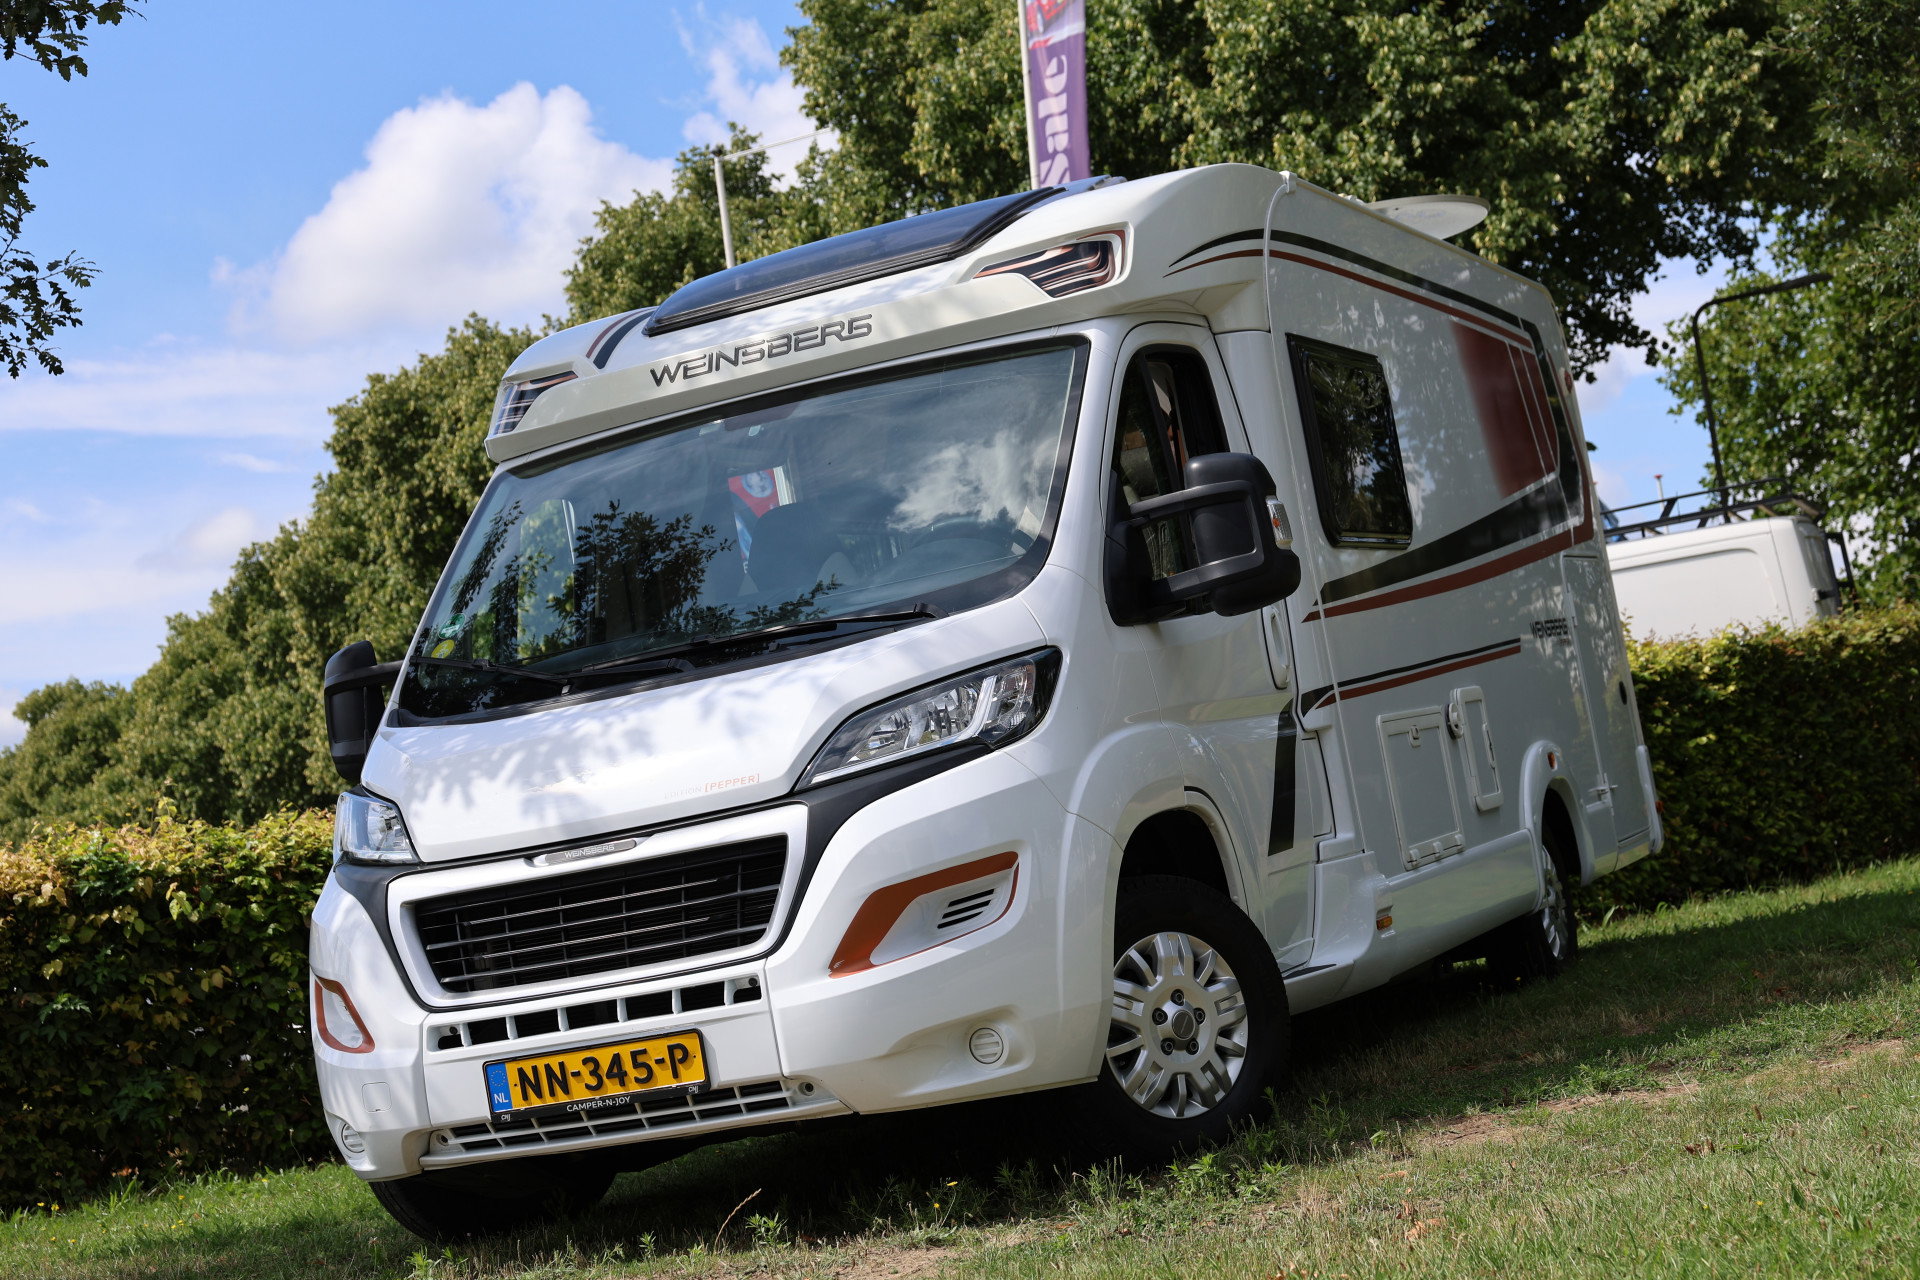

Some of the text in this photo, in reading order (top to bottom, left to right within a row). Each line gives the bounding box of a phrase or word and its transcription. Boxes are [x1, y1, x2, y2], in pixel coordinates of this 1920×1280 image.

[650, 313, 873, 387] WEINSBERG
[564, 844, 615, 859] WEINSBERG
[516, 1042, 689, 1101] NN-345-P
[494, 1093, 509, 1105] NL
[566, 1096, 631, 1112] CAMPER-N-JOY
